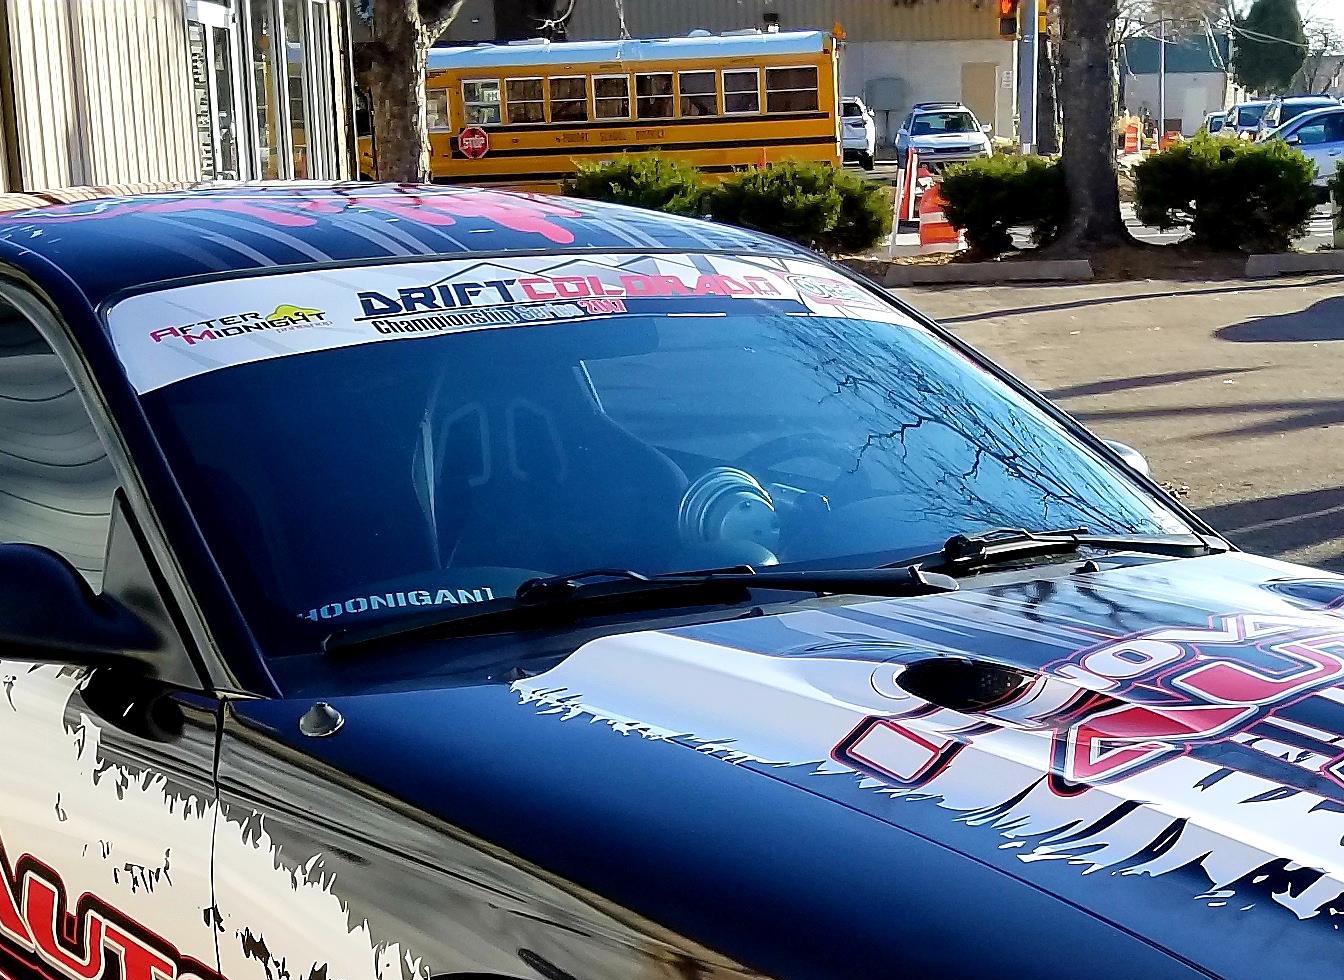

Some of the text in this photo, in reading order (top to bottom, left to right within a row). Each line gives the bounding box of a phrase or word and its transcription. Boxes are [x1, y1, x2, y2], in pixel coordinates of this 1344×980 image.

[462, 134, 486, 149] STOP
[150, 311, 264, 343] AFTER
[182, 311, 326, 345] MIDNIGHT
[371, 305, 519, 334] Championship
[514, 302, 585, 321] Series
